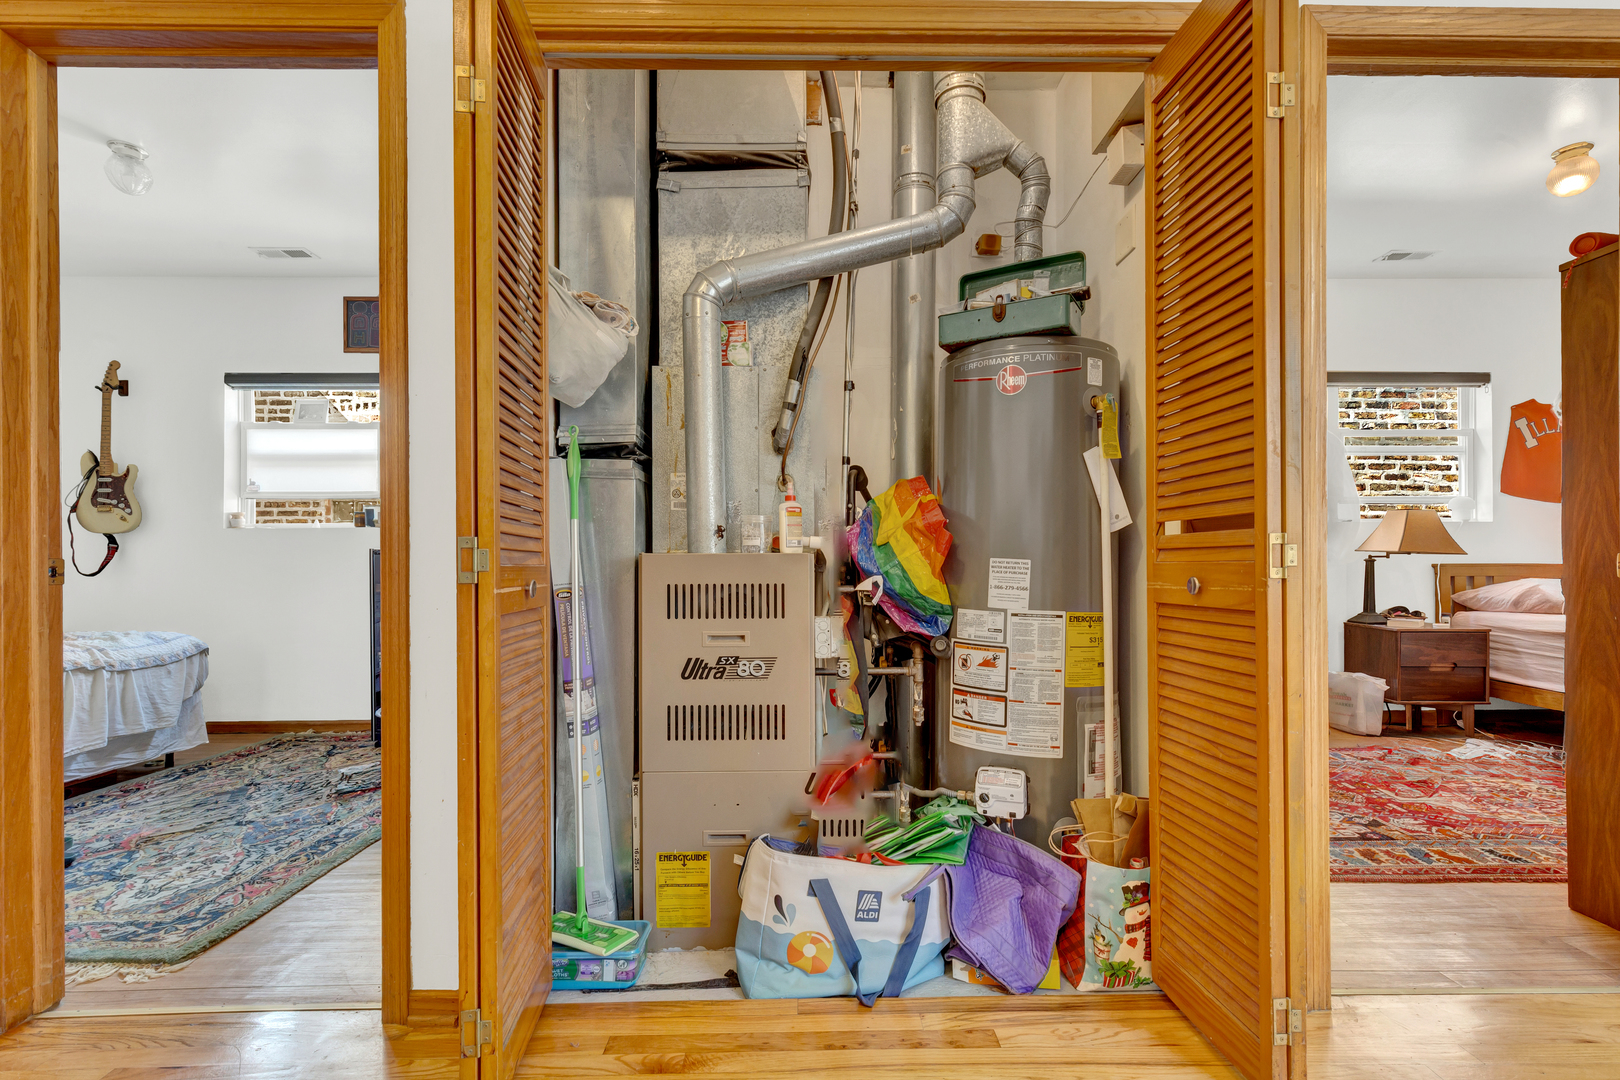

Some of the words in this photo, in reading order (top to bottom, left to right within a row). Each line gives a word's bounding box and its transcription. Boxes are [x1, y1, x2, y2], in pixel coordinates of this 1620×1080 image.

[1000, 365, 1025, 390] Rheem
[680, 658, 727, 680] Ultra
[718, 656, 736, 664] SX
[737, 660, 766, 677] 80
[659, 854, 707, 862] ENERGYGUIDE
